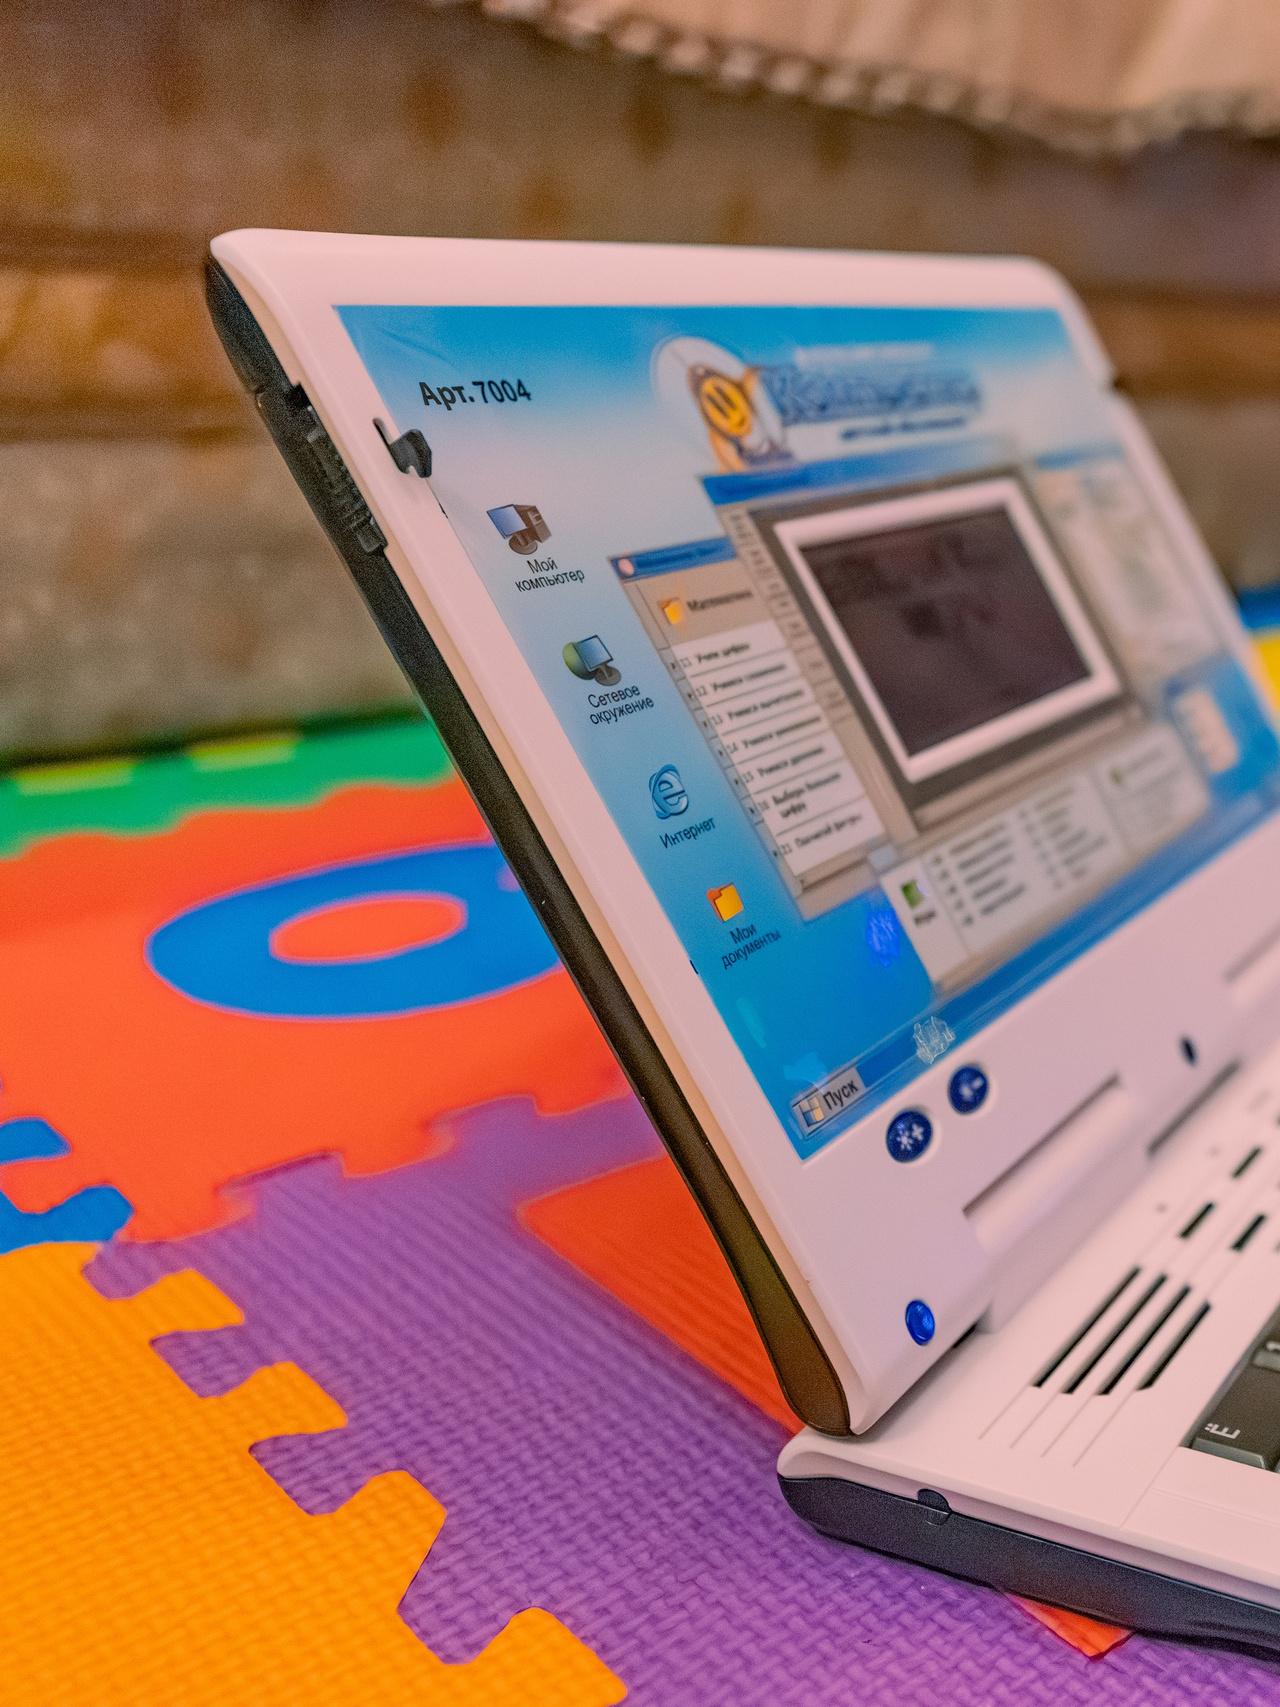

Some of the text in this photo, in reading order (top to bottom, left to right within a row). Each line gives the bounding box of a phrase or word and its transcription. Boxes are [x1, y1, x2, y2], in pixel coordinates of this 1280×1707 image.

[526, 556, 559, 575] Мой
[515, 568, 585, 592] компьютер
[588, 685, 641, 708] Сетевое
[589, 696, 654, 725] окружение
[659, 817, 716, 849] Интернет
[729, 923, 758, 944] Мои
[721, 930, 782, 970] документы
[823, 1079, 859, 1110] Пуск
[1204, 1422, 1241, 1439] Ё
